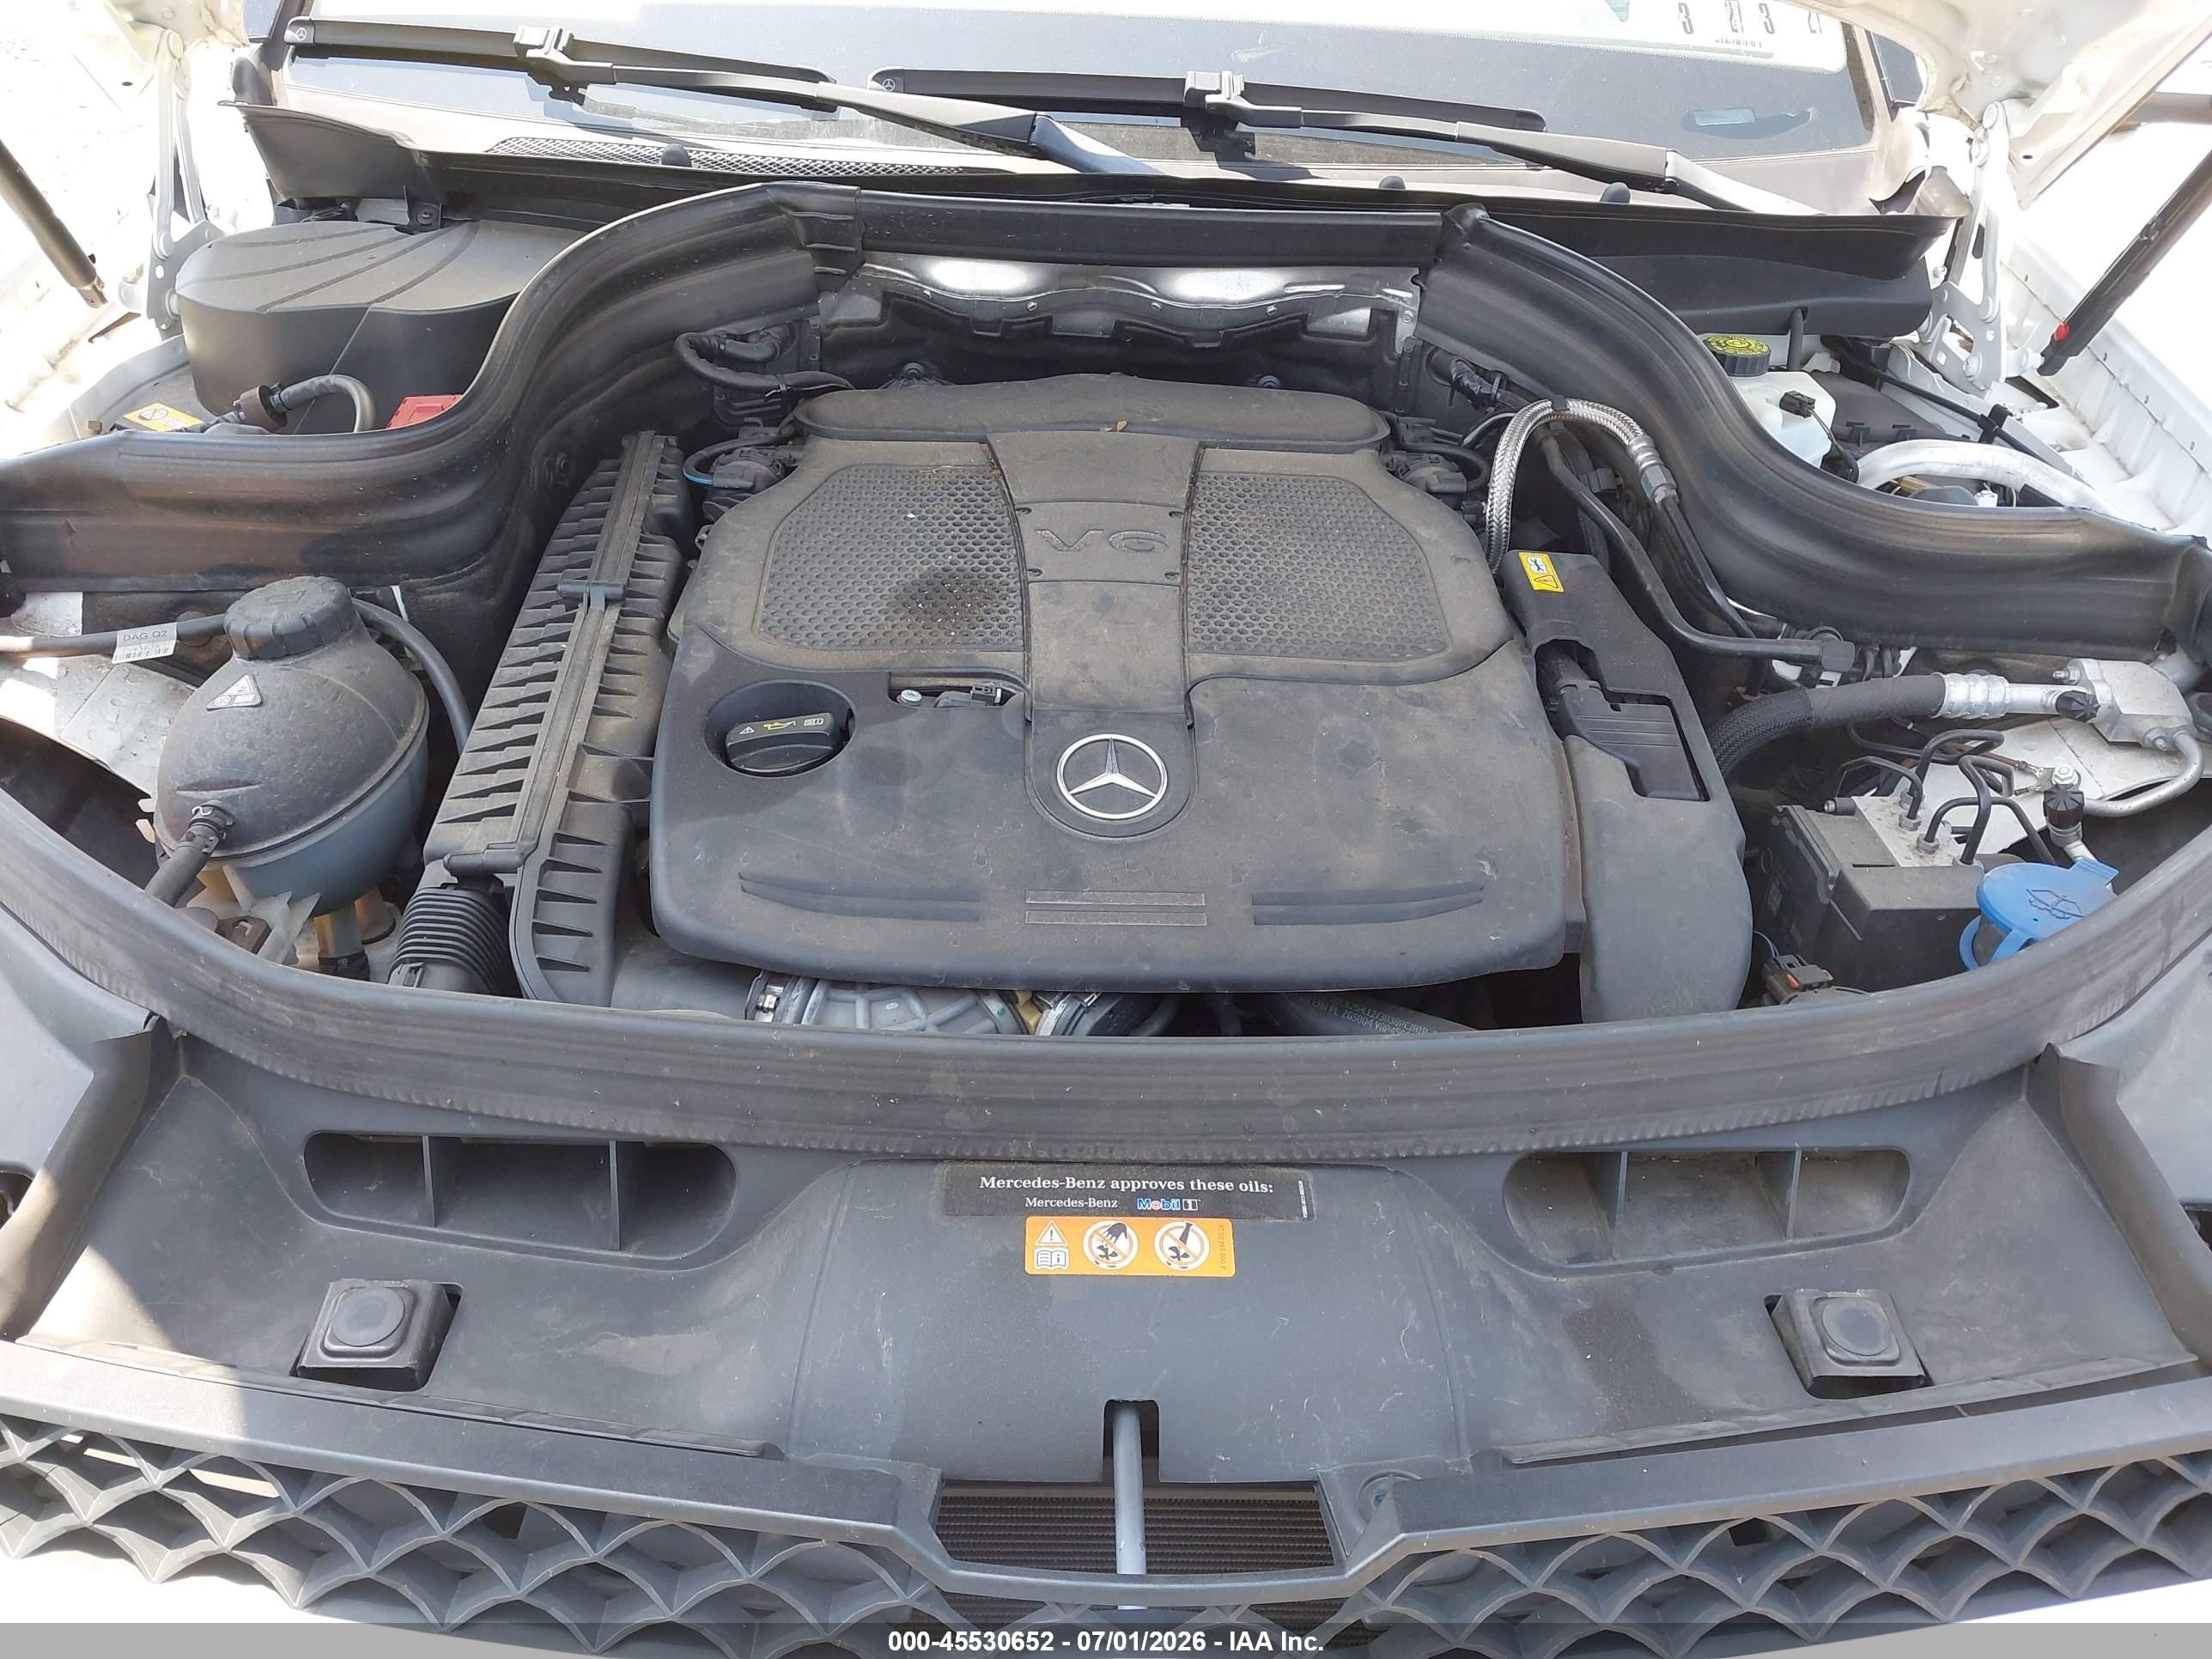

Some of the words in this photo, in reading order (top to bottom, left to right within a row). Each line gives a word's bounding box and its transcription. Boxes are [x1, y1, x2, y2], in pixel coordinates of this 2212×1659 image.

[1033, 528, 1170, 553] V6
[123, 632, 149, 641] DAG
[152, 629, 167, 639] Q2
[979, 1176, 1106, 1189] Mercedes-Benz
[1110, 1179, 1185, 1191] approves
[1190, 1179, 1234, 1191] these
[1239, 1181, 1273, 1193] oils:
[1024, 1197, 1118, 1208] Mercedes-Benz
[1137, 1198, 1181, 1210] Mobil
